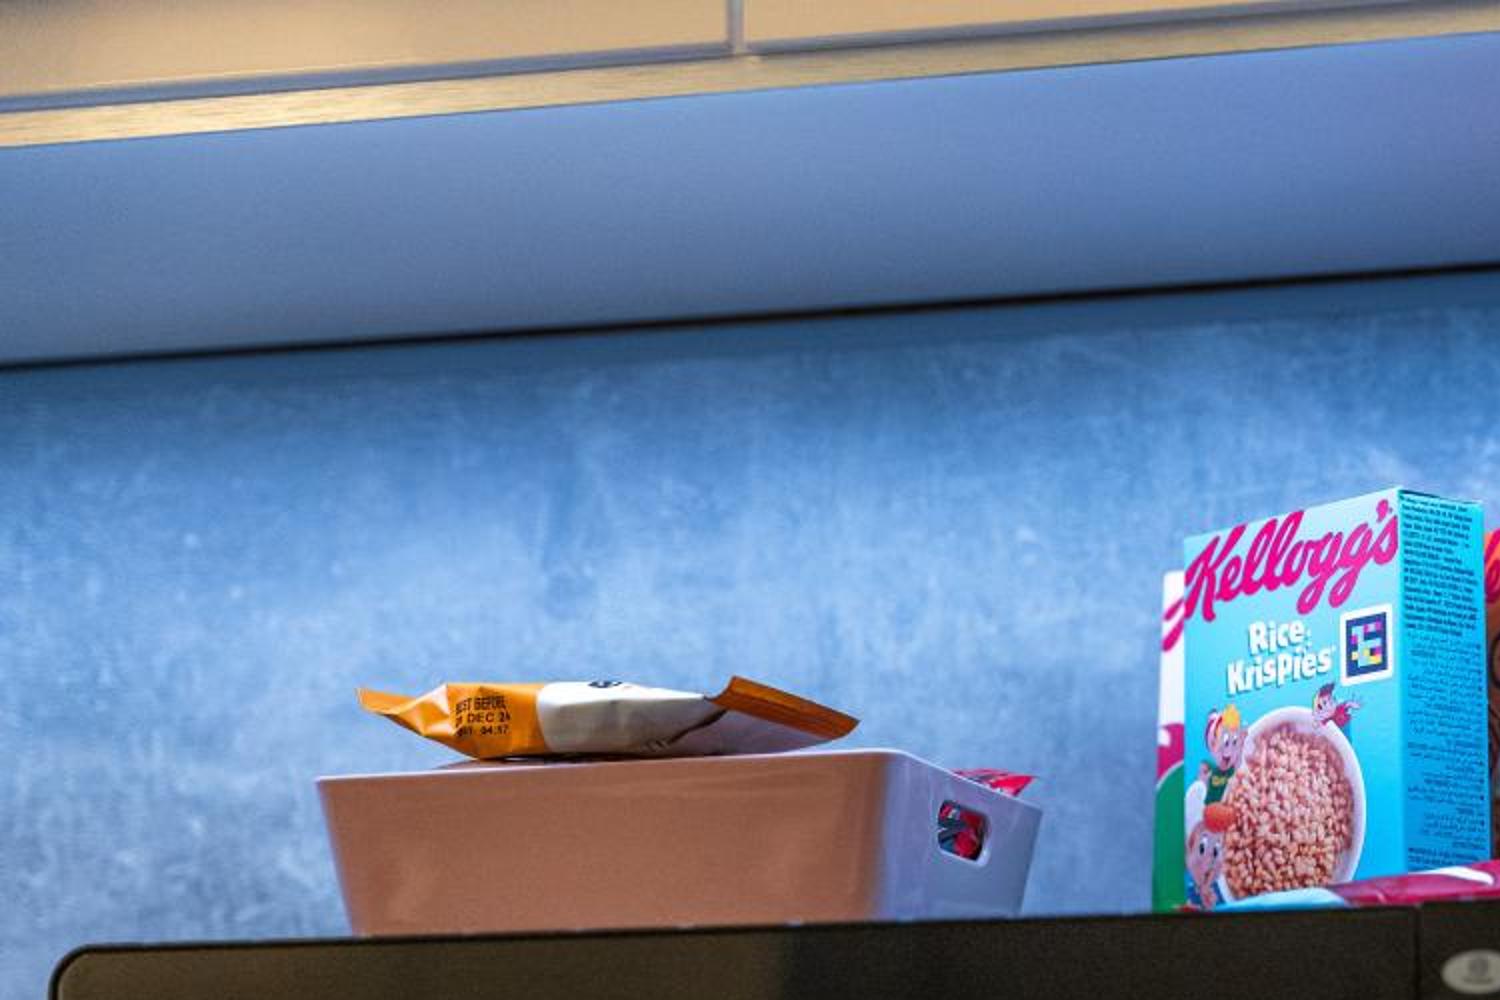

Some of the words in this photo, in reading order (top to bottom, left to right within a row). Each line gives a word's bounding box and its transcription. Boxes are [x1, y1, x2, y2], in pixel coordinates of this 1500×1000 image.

[1164, 499, 1399, 648] Kellogg's
[1248, 620, 1307, 655] Rice
[1226, 648, 1332, 696] Krispies
[467, 711, 495, 724] DEC
